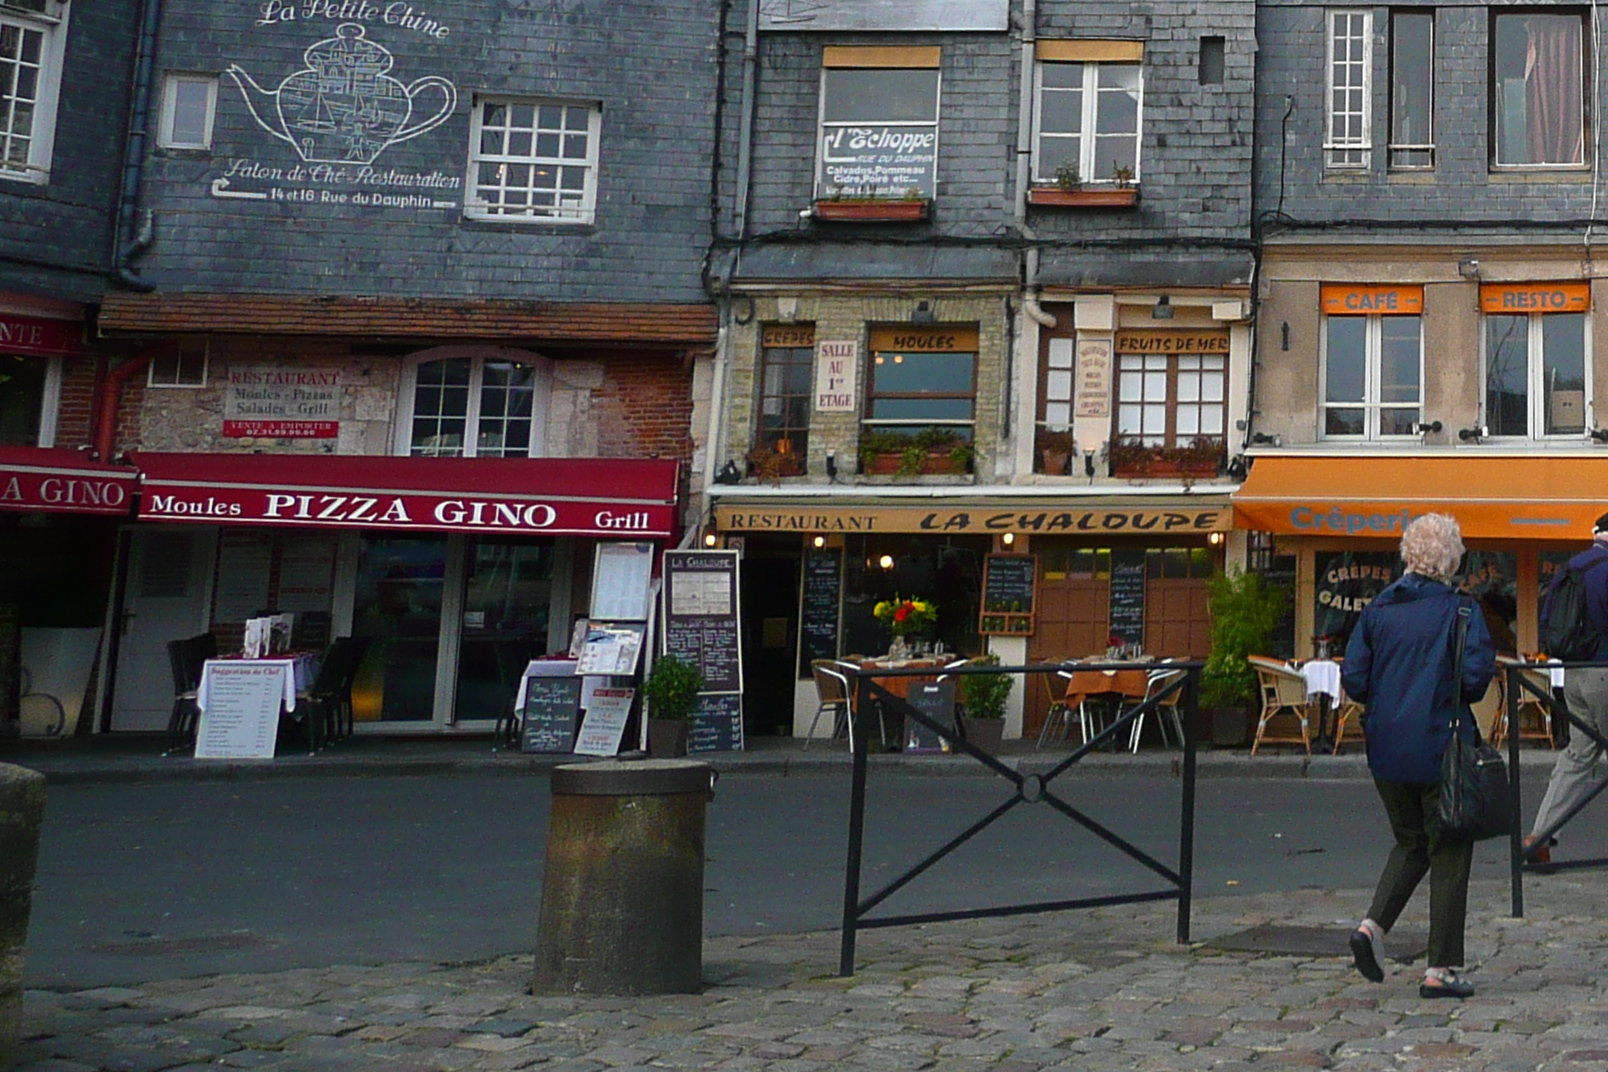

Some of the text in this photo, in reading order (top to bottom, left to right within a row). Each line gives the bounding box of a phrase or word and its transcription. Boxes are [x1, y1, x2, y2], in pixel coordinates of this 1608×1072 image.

[254, 0, 295, 27] La
[383, 1, 451, 38] Chine
[224, 158, 282, 180] Salon
[287, 165, 307, 181] de
[351, 166, 460, 188] Restauration
[271, 188, 431, 208] 14 et 16 Rue du Dauphin
[1345, 291, 1398, 310] CAFÉ
[1503, 290, 1566, 308] RESTO
[821, 344, 854, 357] SALLE
[893, 335, 955, 349] MOULES
[1120, 337, 1228, 350] FRUITS DE MER
[828, 361, 844, 374] AU
[231, 371, 340, 386] RESTAURANT
[234, 388, 280, 401] Moules
[293, 389, 333, 401] Pizzas
[819, 394, 852, 407] ETAGE
[236, 402, 328, 415] Salades Grill
[40, 479, 124, 506] GINO
[150, 493, 649, 529] Moules PIZZA GINO Grill
[730, 512, 1220, 531] RESTAURANT LA CHALOUPE
[1290, 505, 1421, 536] Crêperi
[1319, 590, 1372, 612] GALET
